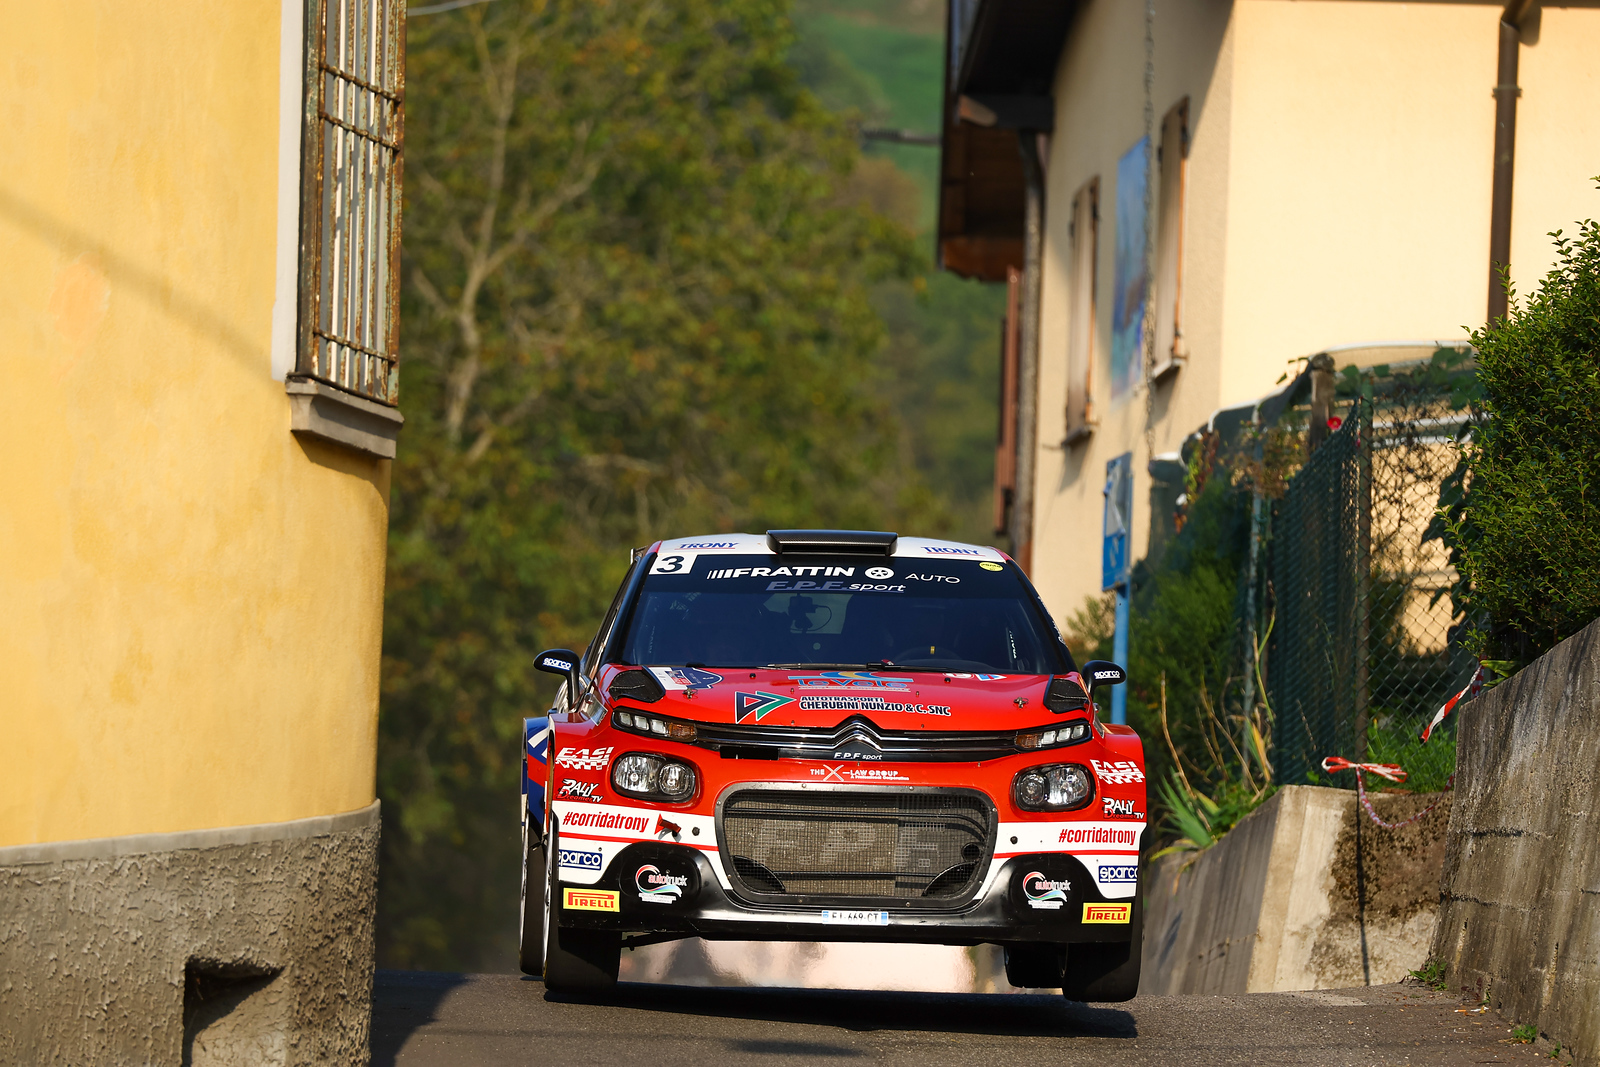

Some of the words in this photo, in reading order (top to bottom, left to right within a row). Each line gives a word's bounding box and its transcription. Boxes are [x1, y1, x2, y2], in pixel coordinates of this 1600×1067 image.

[921, 546, 982, 555] TRONY
[656, 555, 685, 573] 3
[731, 566, 856, 579] FRATTIN
[905, 573, 960, 584] AUTO
[848, 583, 907, 592] sport
[543, 657, 573, 669] sparco
[1094, 670, 1121, 679] sparco
[800, 701, 860, 710] CHERUBINI
[861, 701, 903, 711] NUNZIO
[905, 703, 915, 712] &
[916, 703, 927, 714] C.
[928, 705, 952, 715] SNC
[868, 769, 899, 777] GROUP
[562, 811, 650, 833] #corridatrony
[1058, 826, 1136, 846] #corridatrony
[648, 873, 688, 887] autotruck
[1034, 879, 1072, 891] autotruck
[568, 891, 615, 909] PIRELLI
[1086, 906, 1128, 921] PIRELLI
